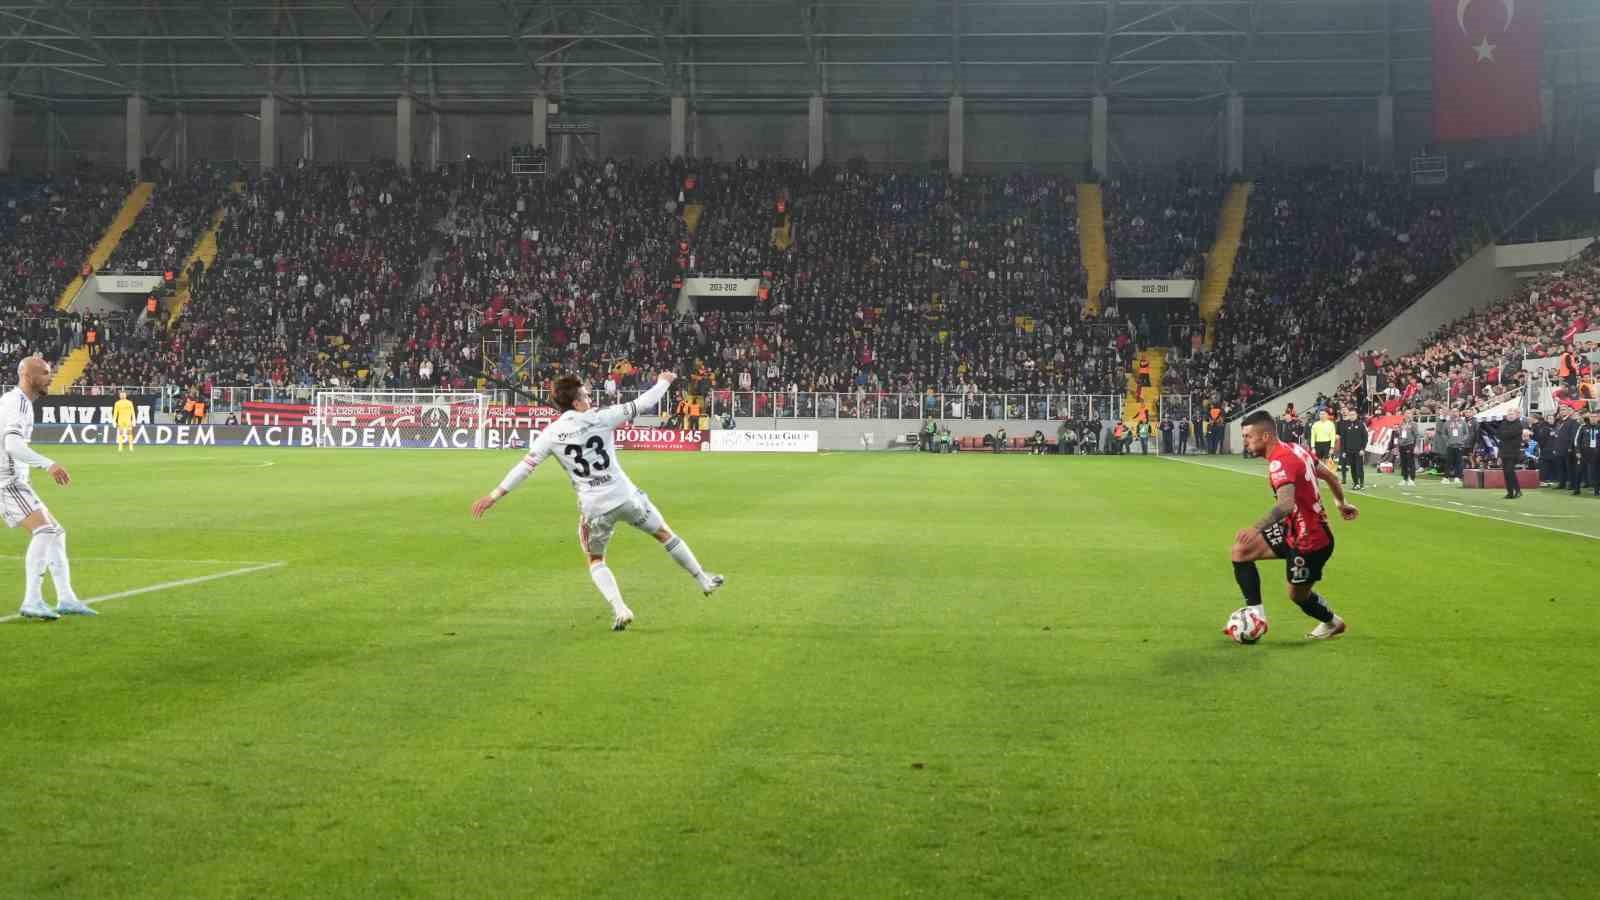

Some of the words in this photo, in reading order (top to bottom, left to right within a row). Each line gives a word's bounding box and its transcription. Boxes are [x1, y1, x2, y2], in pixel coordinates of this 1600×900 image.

[243, 426, 402, 447] ACIBADEM
[615, 429, 676, 443] BORDO
[680, 429, 702, 443] 145
[564, 435, 610, 478] 33
[1290, 566, 1309, 579] 10
